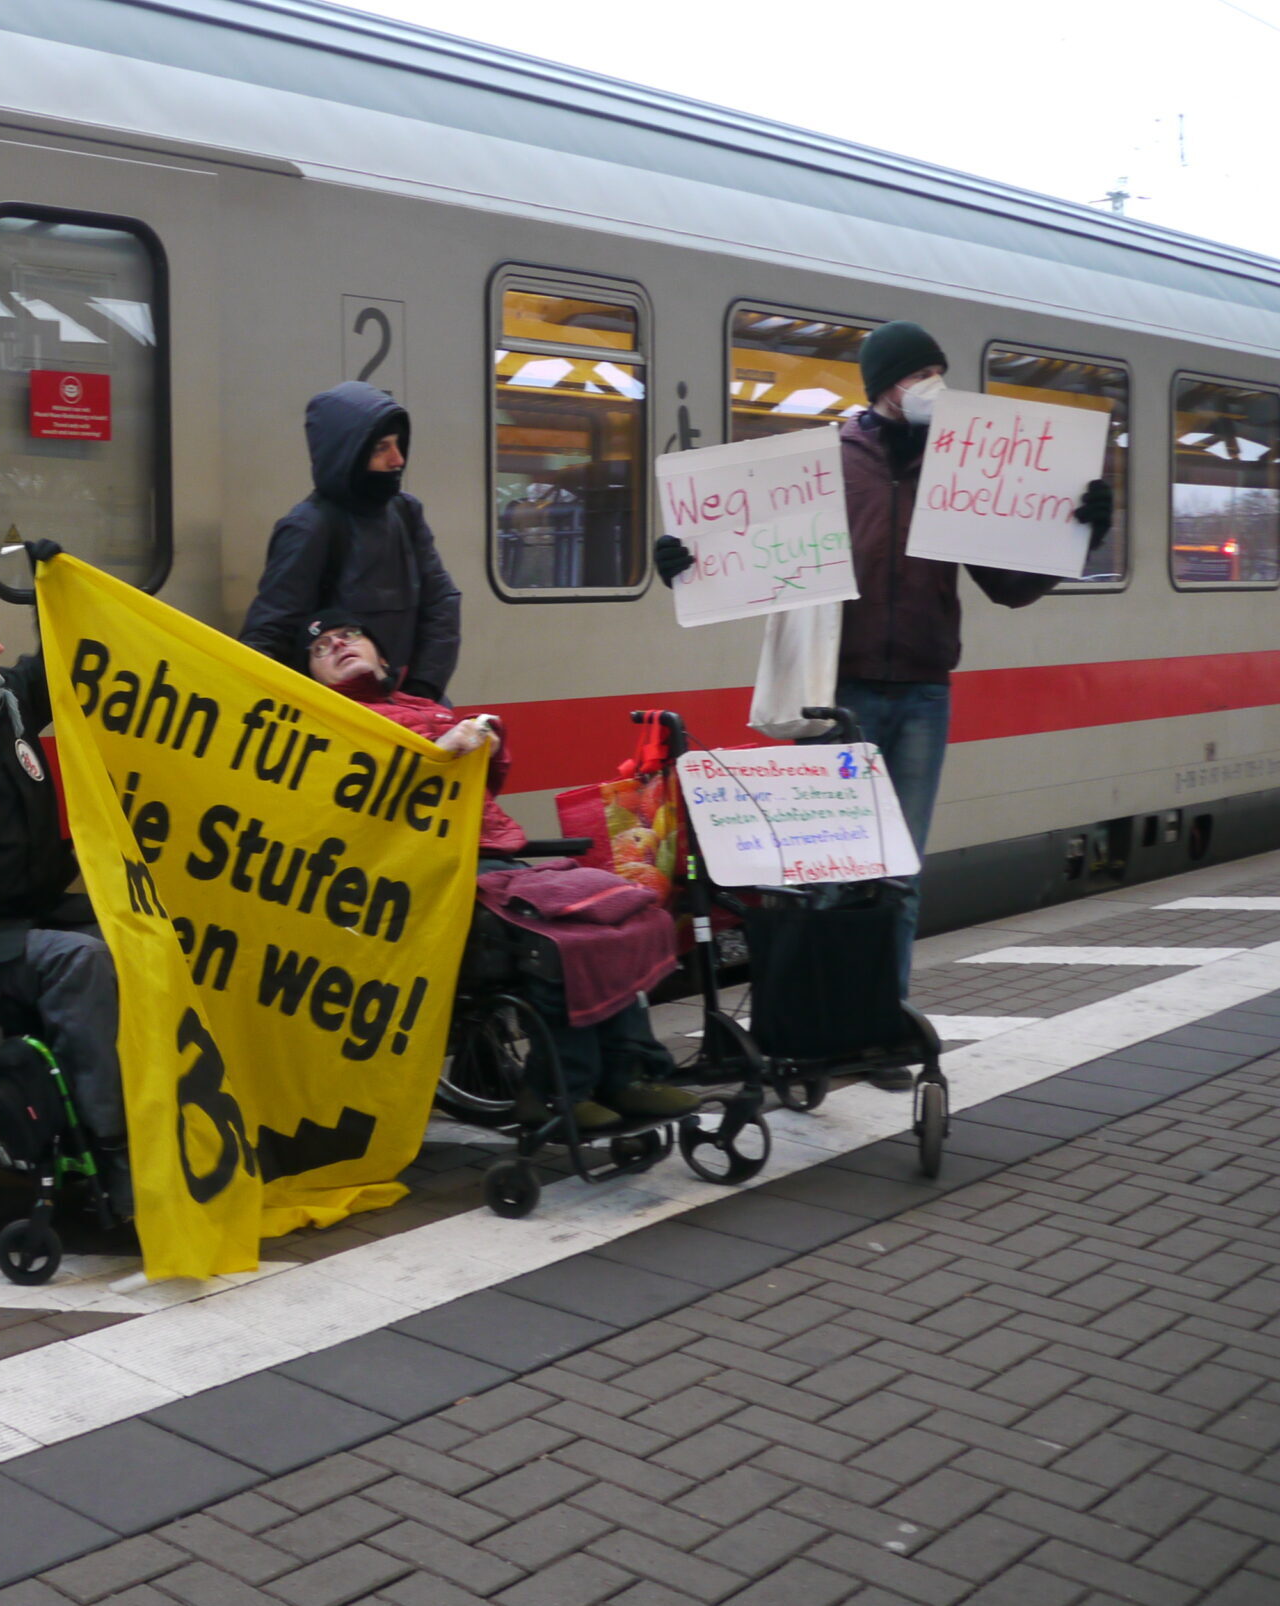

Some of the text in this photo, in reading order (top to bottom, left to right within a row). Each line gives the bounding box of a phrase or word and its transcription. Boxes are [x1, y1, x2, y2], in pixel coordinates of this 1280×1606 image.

[353, 306, 393, 396] 2
[932, 413, 1053, 479] #fight
[666, 459, 836, 536] Weg mit
[927, 472, 1075, 524] abelism
[752, 512, 852, 574] Stufen
[71, 638, 460, 838] Bahn für alle:
[117, 771, 412, 943] ie Stufen
[257, 943, 429, 1062] weg!
